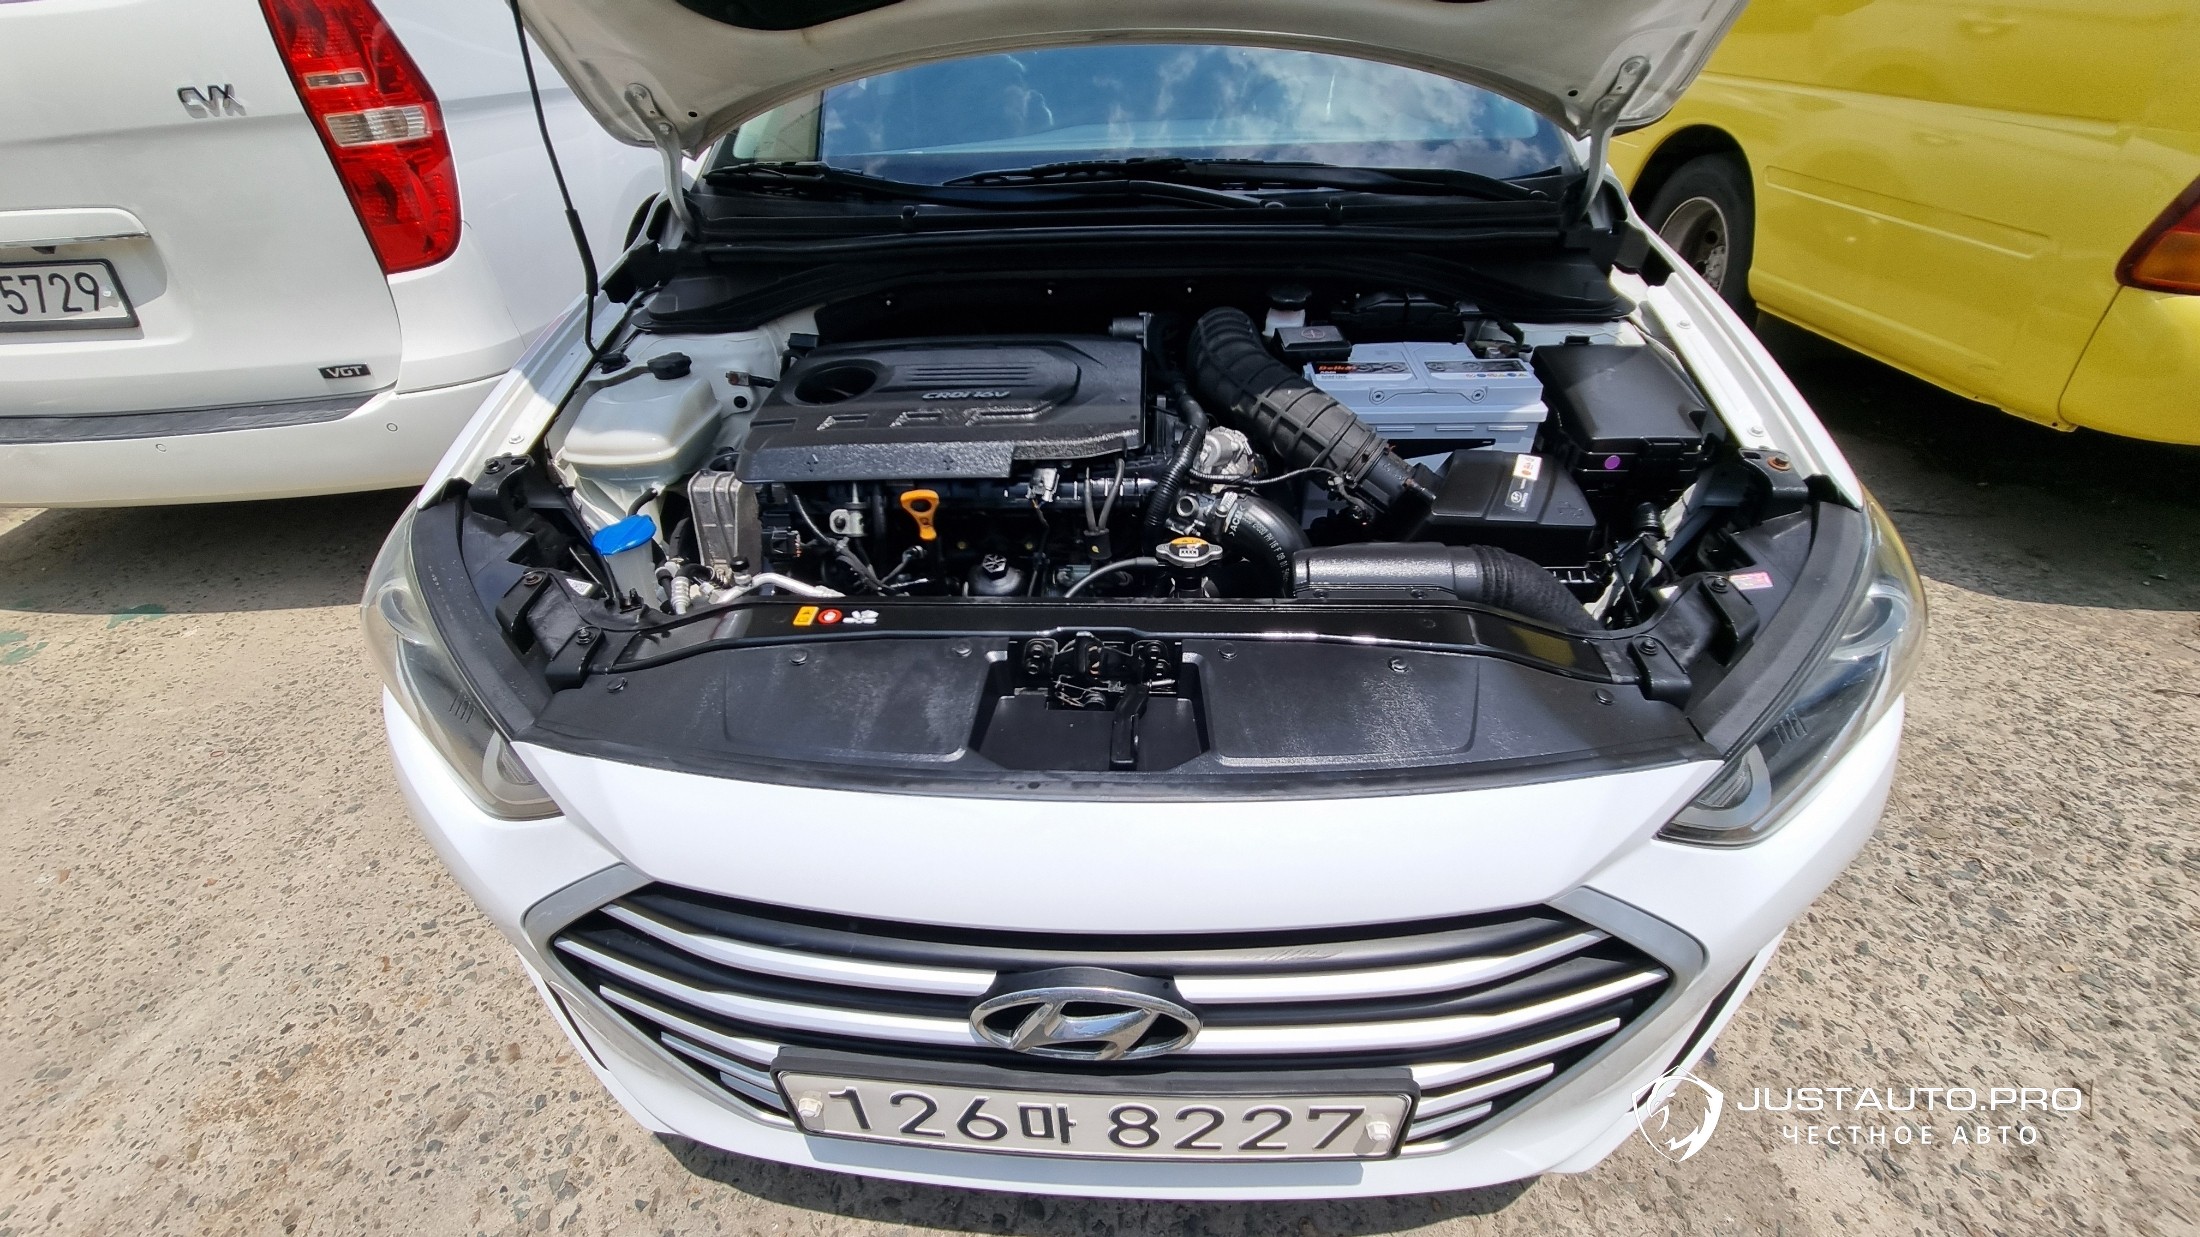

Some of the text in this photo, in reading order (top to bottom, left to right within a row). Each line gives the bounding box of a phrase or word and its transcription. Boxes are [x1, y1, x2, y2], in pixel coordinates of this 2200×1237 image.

[0, 272, 100, 314] 5729
[326, 365, 362, 378] VGT
[829, 1087, 1367, 1150] 126마 8227
